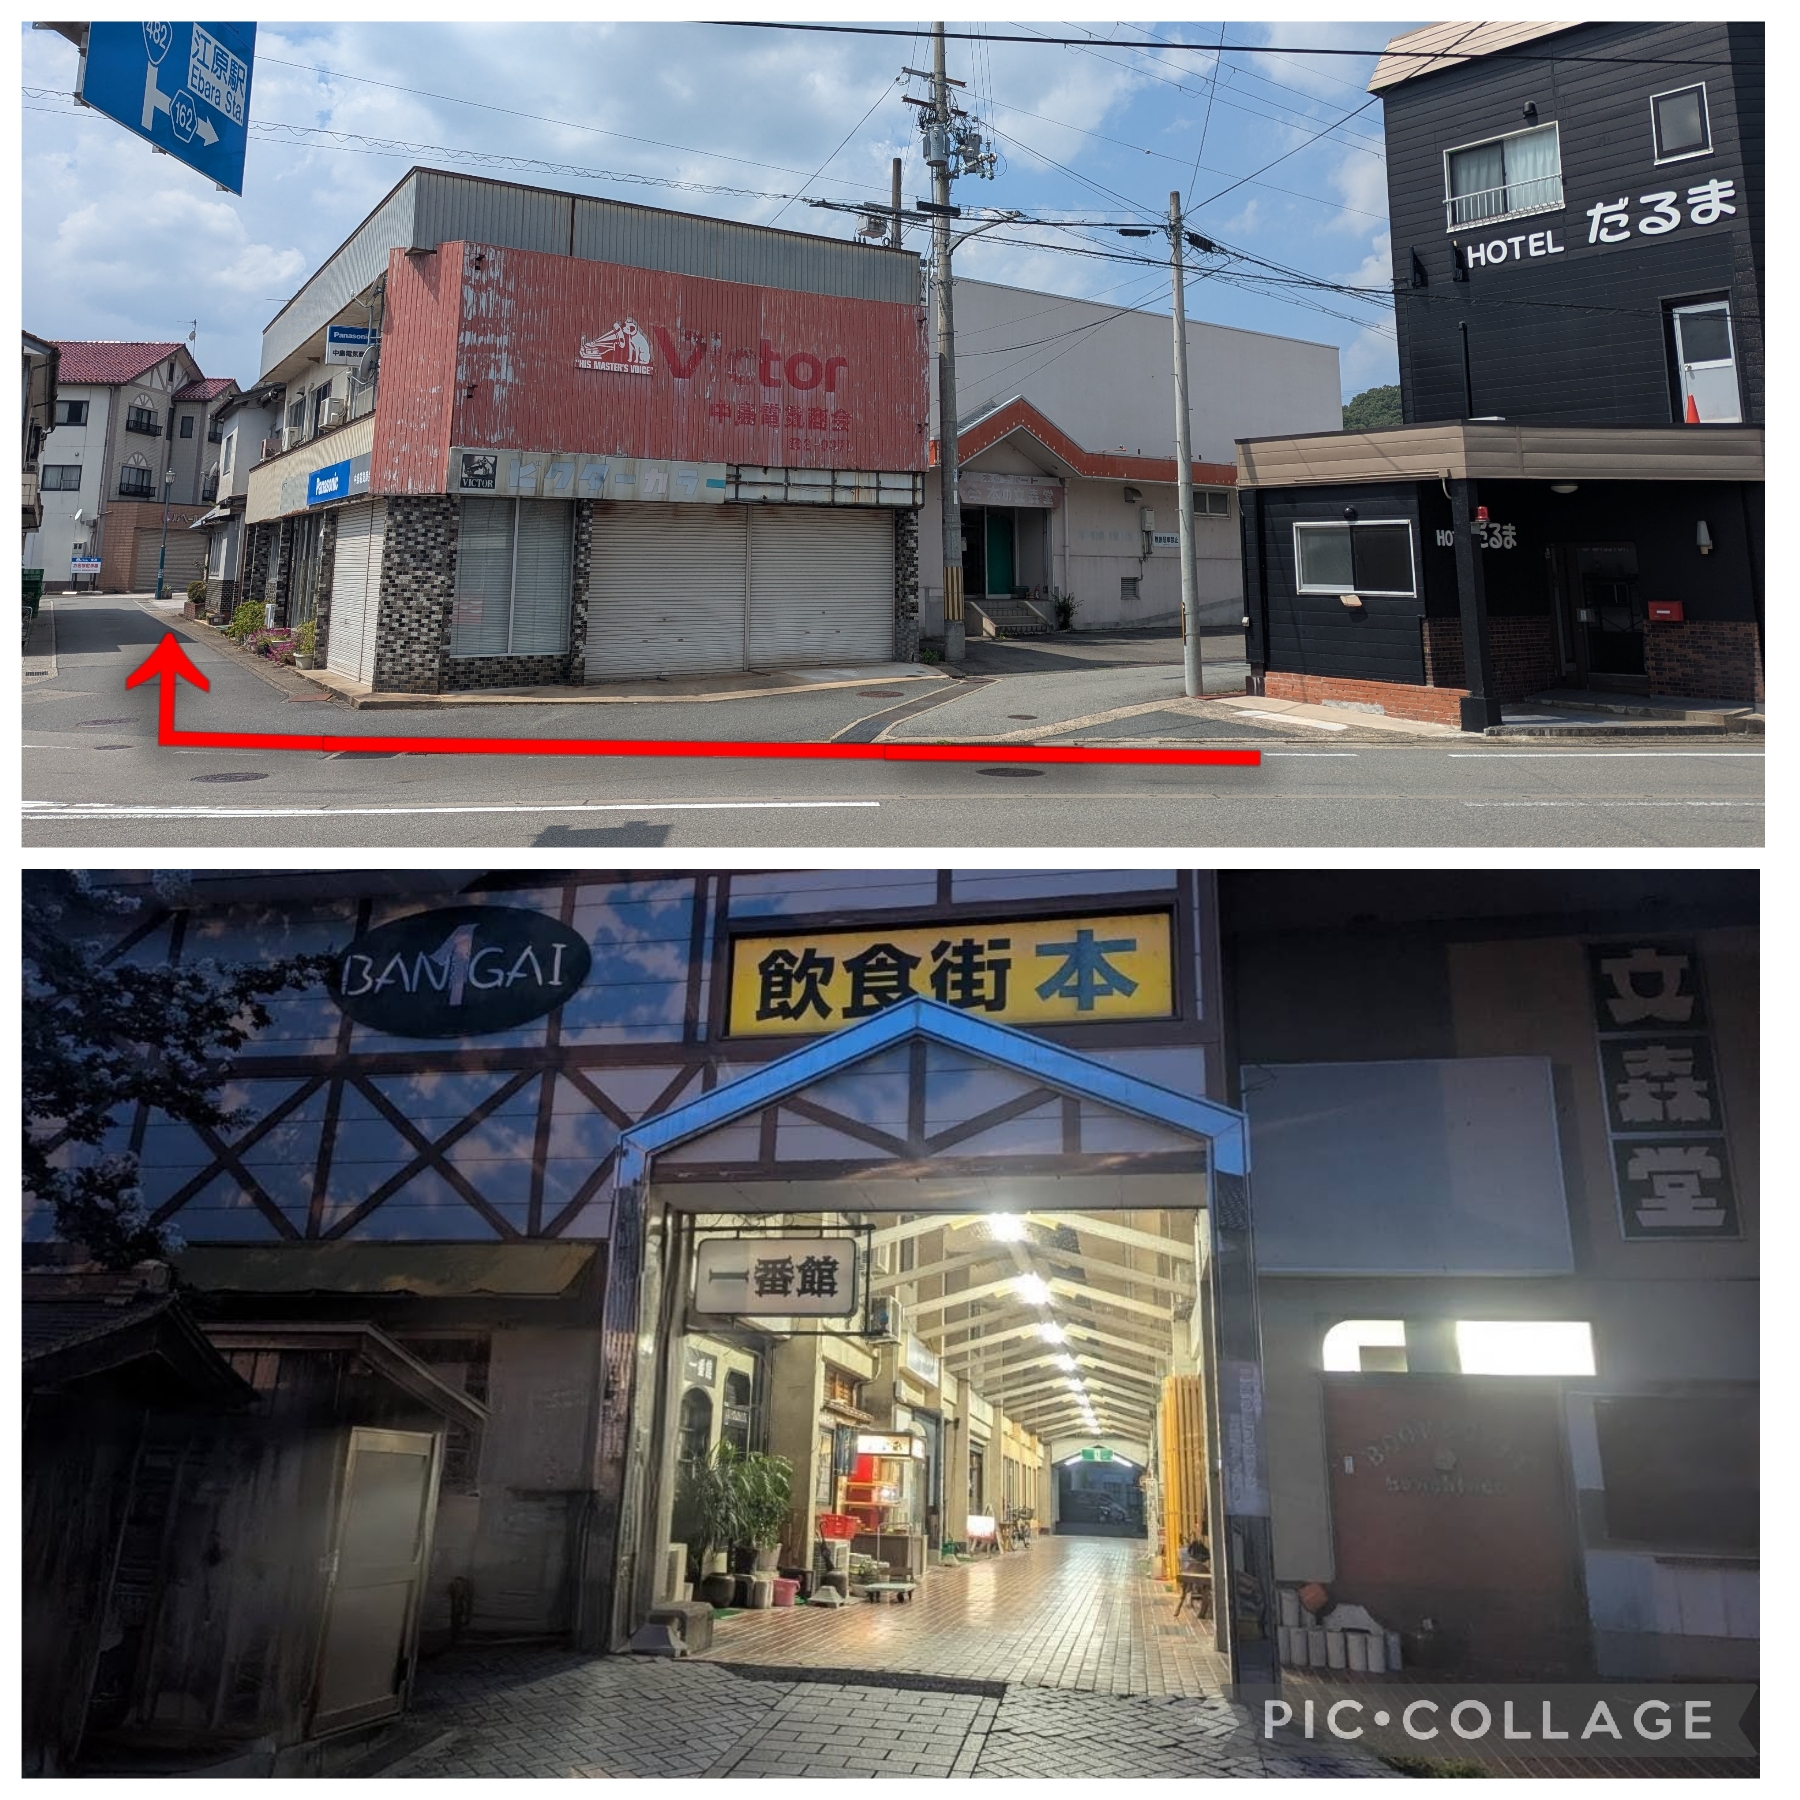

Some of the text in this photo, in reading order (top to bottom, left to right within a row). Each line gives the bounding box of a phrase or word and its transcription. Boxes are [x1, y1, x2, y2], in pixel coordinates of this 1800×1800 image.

[146, 21, 167, 49] 482
[192, 29, 246, 98] 江原駅
[190, 64, 243, 124] Ebara Sta.
[176, 101, 192, 132] 162
[1468, 179, 1736, 268] HOTEL だるま
[594, 361, 629, 372] MASTER'S
[653, 323, 848, 392] Victor
[315, 471, 339, 496] Panasonic
[462, 477, 495, 489] VICTOR
[755, 929, 1139, 1021] 飲食街 本
[708, 1255, 839, 1298] 一番館
